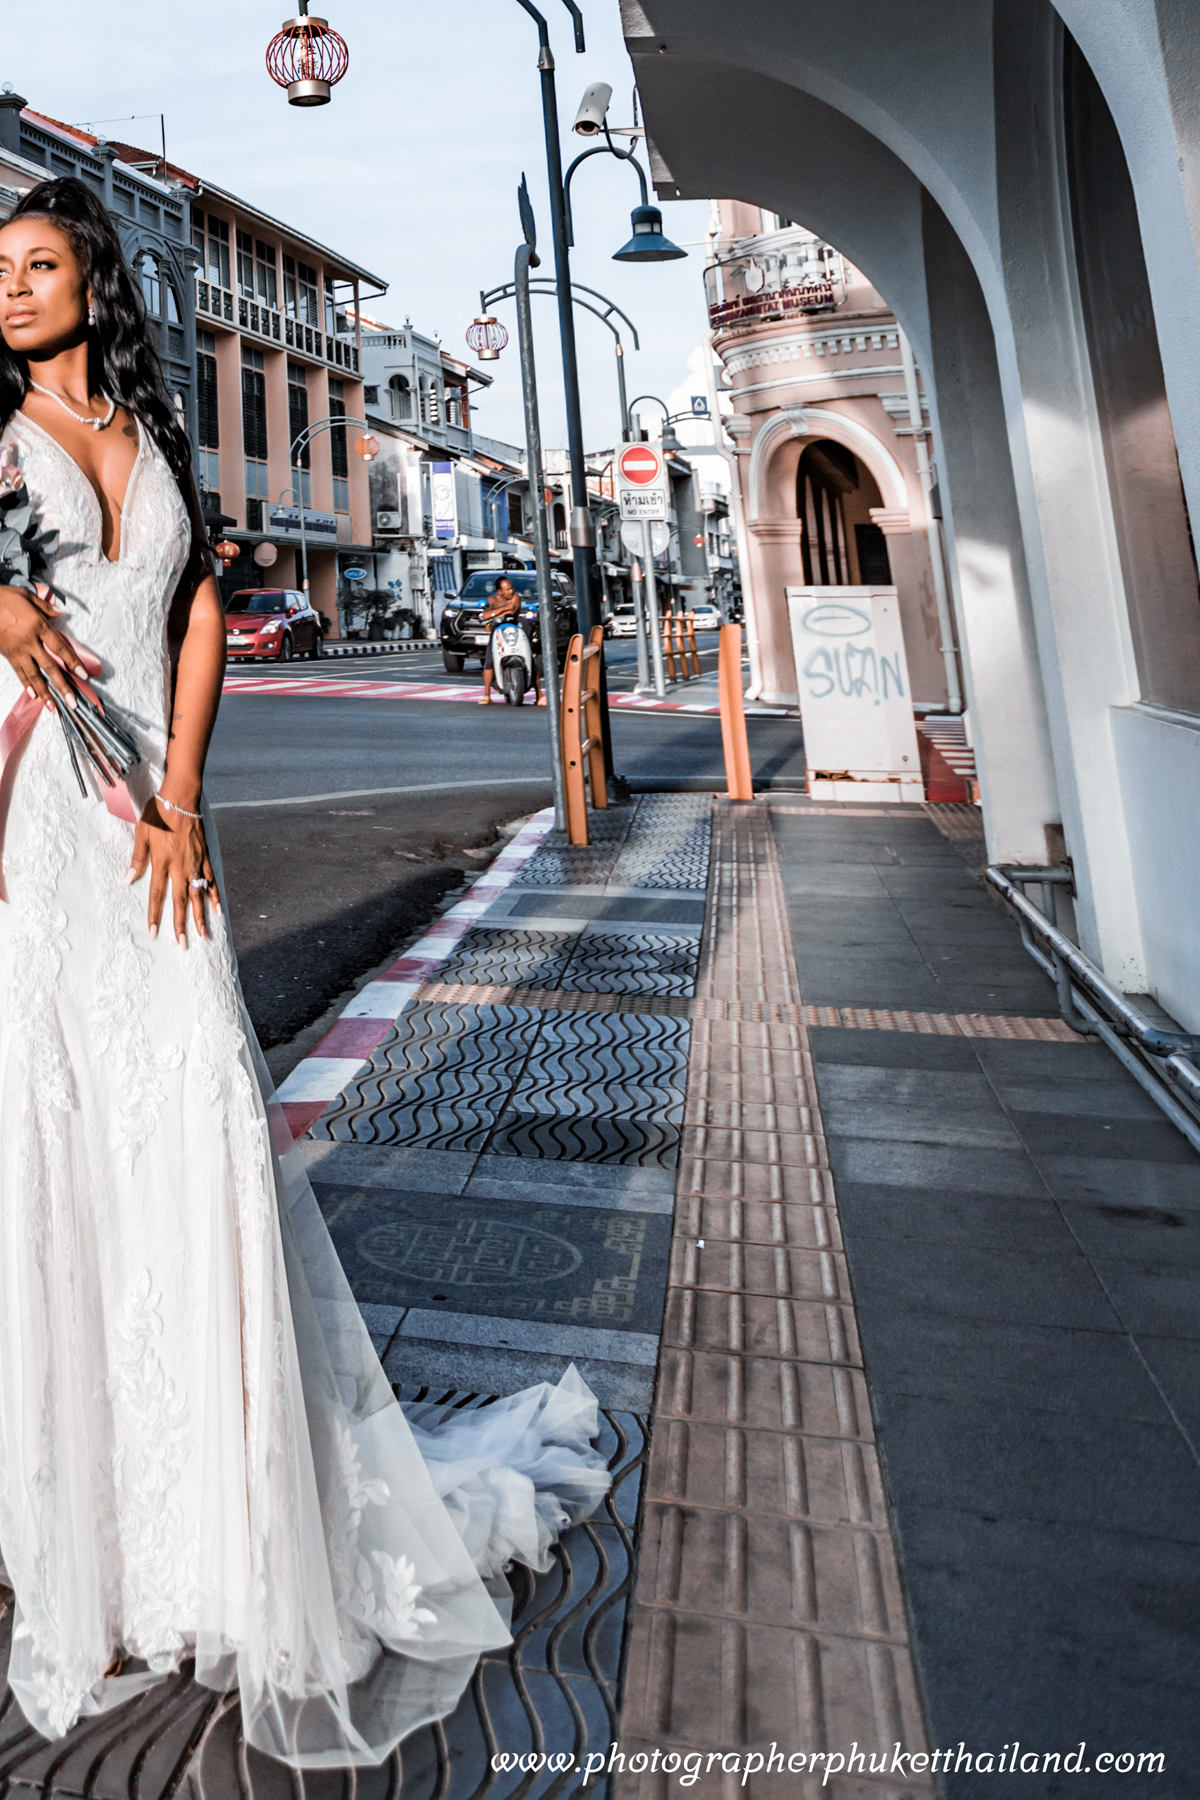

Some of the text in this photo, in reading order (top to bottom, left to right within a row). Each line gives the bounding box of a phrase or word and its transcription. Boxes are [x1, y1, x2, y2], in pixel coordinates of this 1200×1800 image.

[781, 293, 834, 310] MUSEUM
[623, 492, 663, 505] ห้ามเข้า
